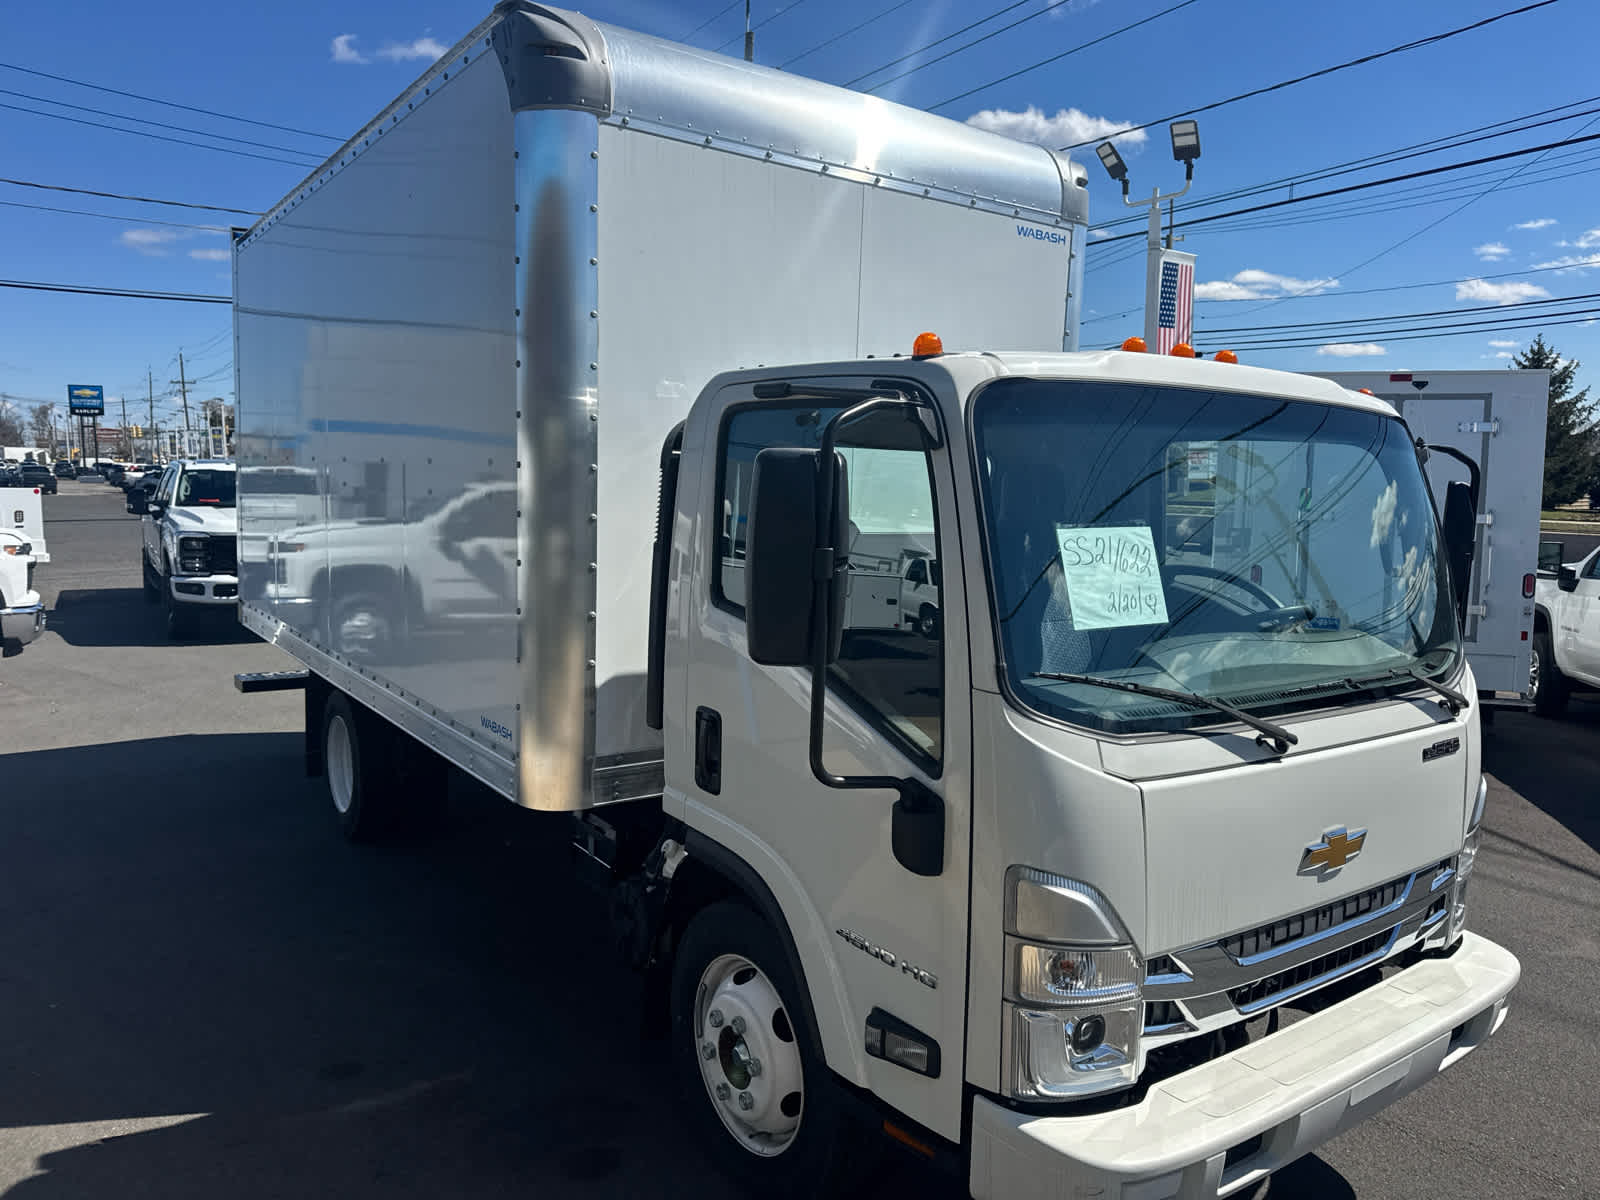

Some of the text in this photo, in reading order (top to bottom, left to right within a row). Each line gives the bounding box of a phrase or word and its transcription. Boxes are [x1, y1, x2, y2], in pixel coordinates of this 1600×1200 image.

[1016, 225, 1066, 246] WABASH
[480, 714, 513, 741] WABASH
[836, 928, 938, 989] 4500 HG
